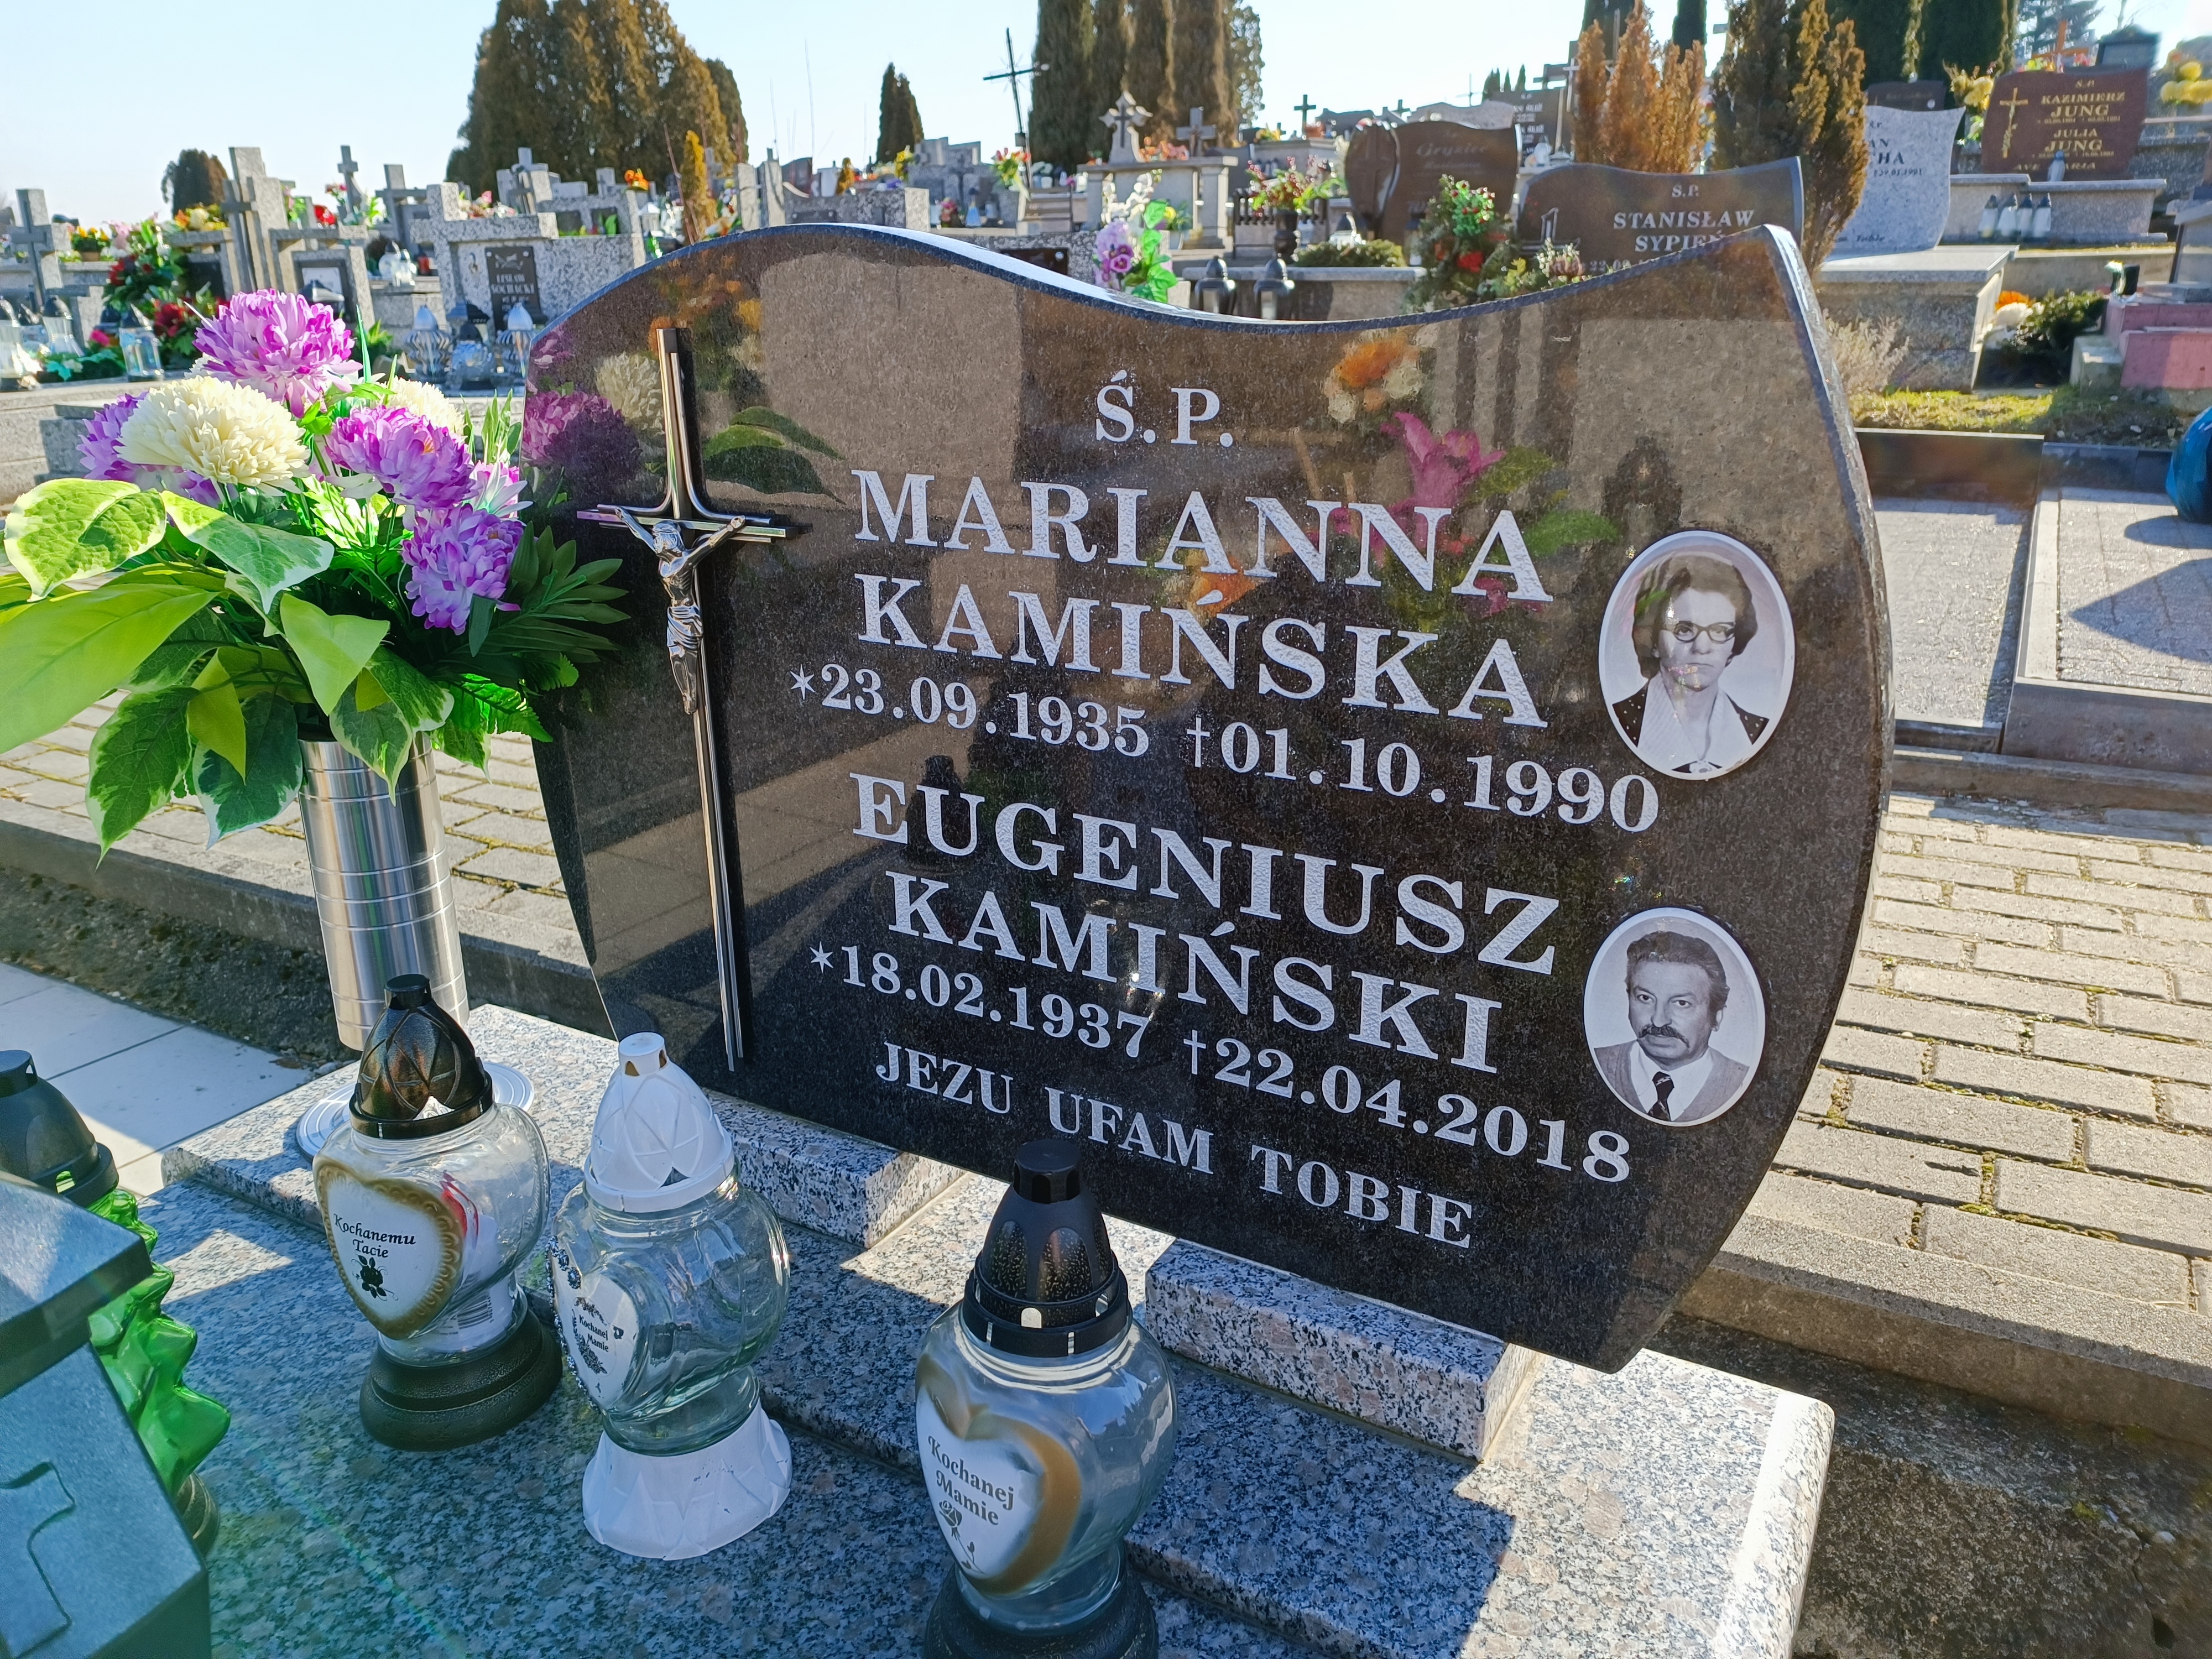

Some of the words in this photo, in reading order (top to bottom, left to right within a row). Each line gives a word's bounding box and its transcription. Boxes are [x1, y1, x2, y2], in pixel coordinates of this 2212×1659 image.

[2051, 104, 2109, 117] JUNG
[2044, 139, 2103, 152] JUNG
[2053, 128, 2098, 138] JULIA
[1613, 210, 1755, 230] STANISŁAW
[1095, 369, 1233, 448] Ś.P.
[852, 470, 1551, 602] MARIANNA
[853, 573, 1548, 728] KAMIŃSKA
[849, 772, 1559, 975] EUGENIUSZ
[885, 870, 1503, 1074] KAMIŃSKI
[875, 1042, 1013, 1115] JEZU
[1044, 1086, 1214, 1175] UFAM
[1251, 1144, 1474, 1249] TOBIE
[333, 1214, 416, 1245] Kochanemu
[352, 1239, 389, 1258] Tacie
[579, 1314, 608, 1341] Kochanej
[587, 1333, 609, 1353] Mamie
[928, 1436, 1014, 1510] Kochanej
[936, 1470, 999, 1525] Mamie
